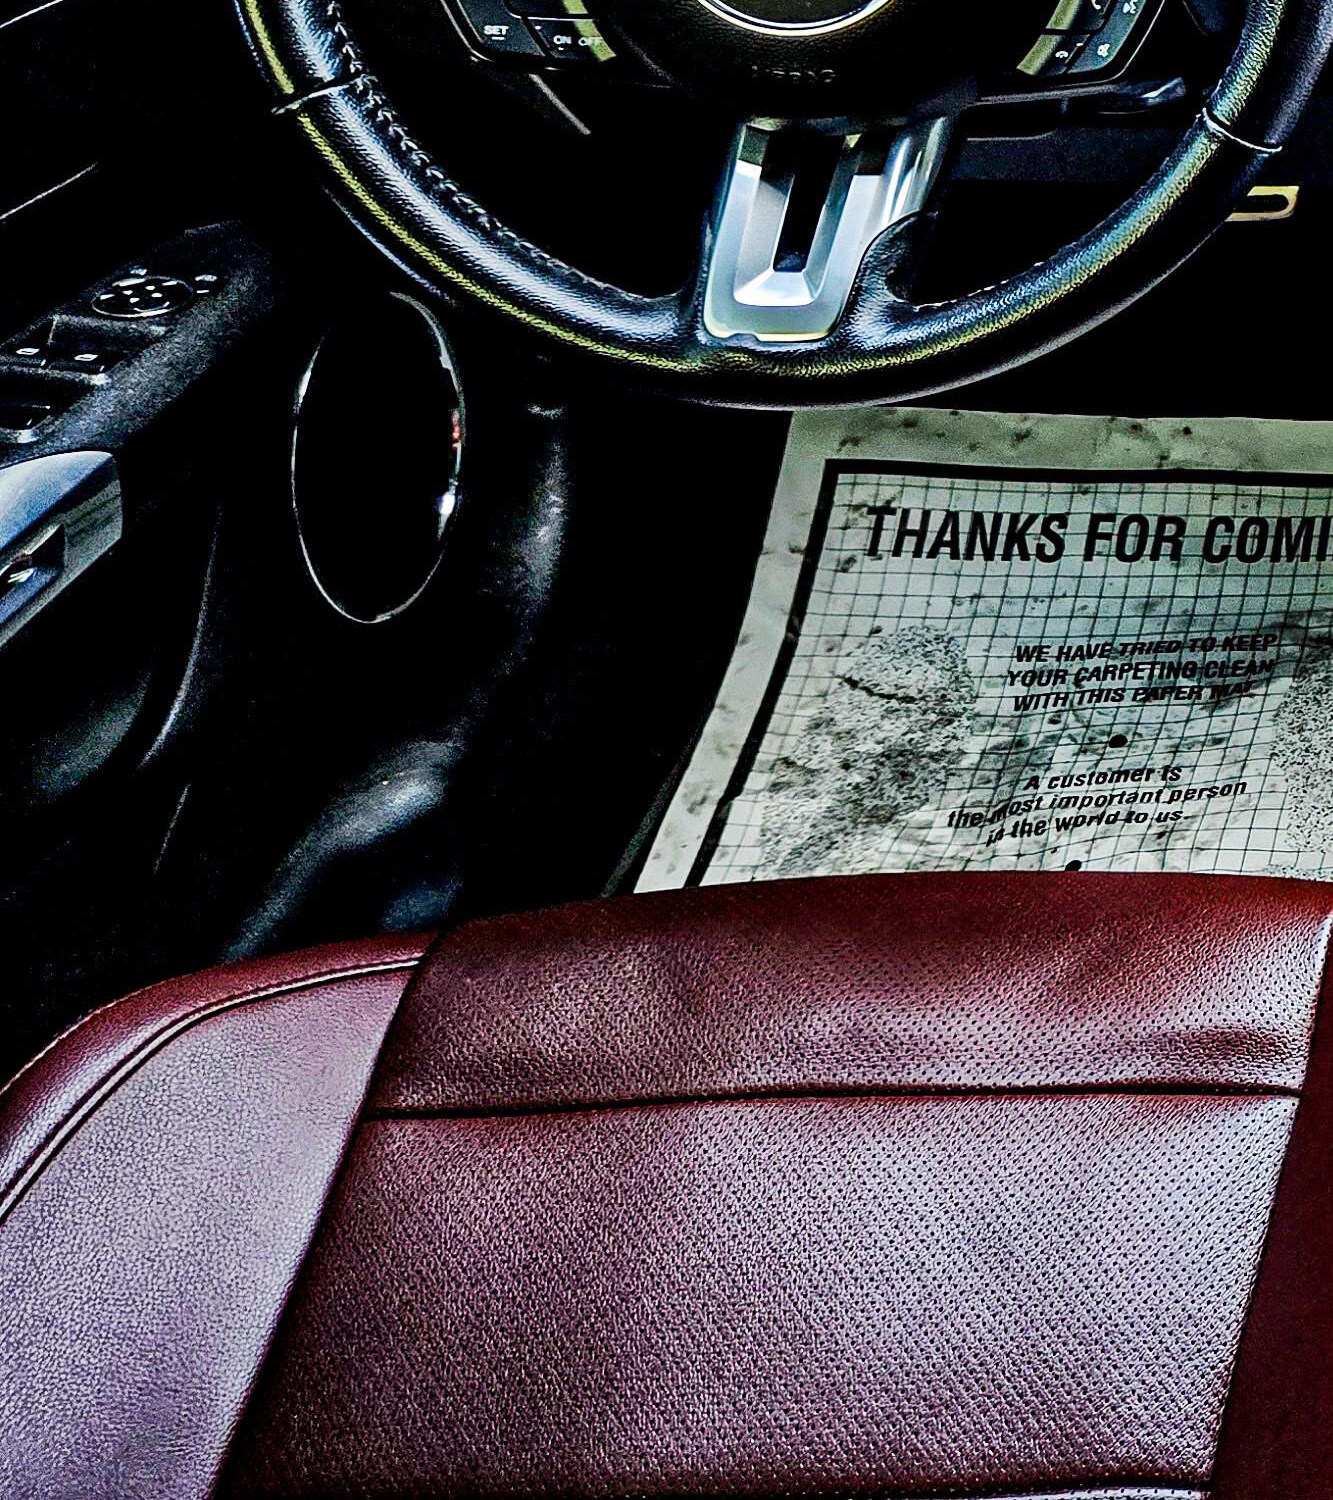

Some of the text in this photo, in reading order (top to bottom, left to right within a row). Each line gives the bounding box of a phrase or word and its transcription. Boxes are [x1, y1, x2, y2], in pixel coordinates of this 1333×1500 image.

[483, 25, 509, 35] SET
[553, 36, 572, 45] ON
[866, 504, 1065, 564] THANKS
[1083, 512, 1184, 564] FOR
[1016, 633, 1278, 663] WE HAVE TRIED TO KEEP
[1007, 659, 1275, 688] YOUR CARPETING CLEAN
[1013, 691, 1073, 712] WITH
[1077, 687, 1126, 706] THIS
[1131, 685, 1204, 702] PAPER
[1023, 766, 1182, 790] A customer is
[948, 781, 1247, 828] the most important person
[1011, 819, 1047, 839] the
[1056, 811, 1120, 833] world
[1124, 809, 1148, 825] to
